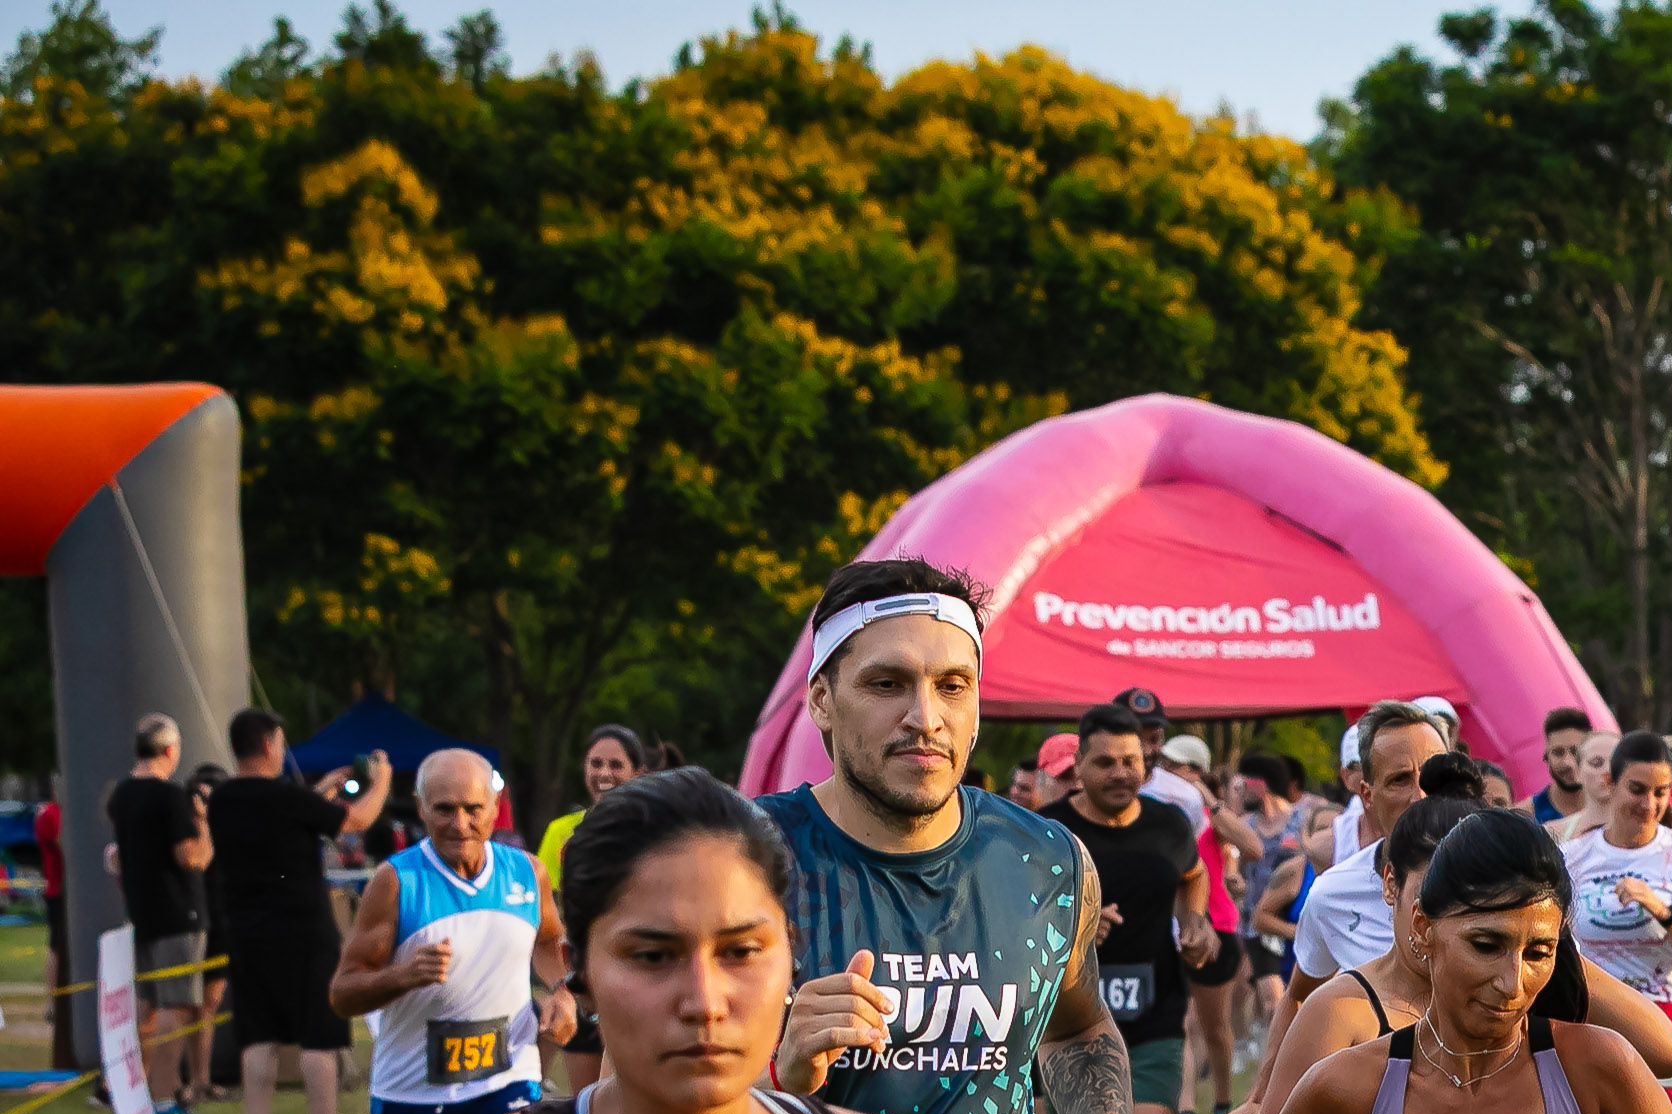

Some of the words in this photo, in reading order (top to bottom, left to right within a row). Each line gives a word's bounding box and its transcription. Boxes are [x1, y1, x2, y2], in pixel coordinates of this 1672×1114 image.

[1034, 591, 1261, 634] Prevención
[1263, 593, 1380, 634] Salud
[882, 952, 979, 981] TEAM
[444, 1032, 496, 1072] 757
[835, 1046, 1008, 1072] SUNCHALES
